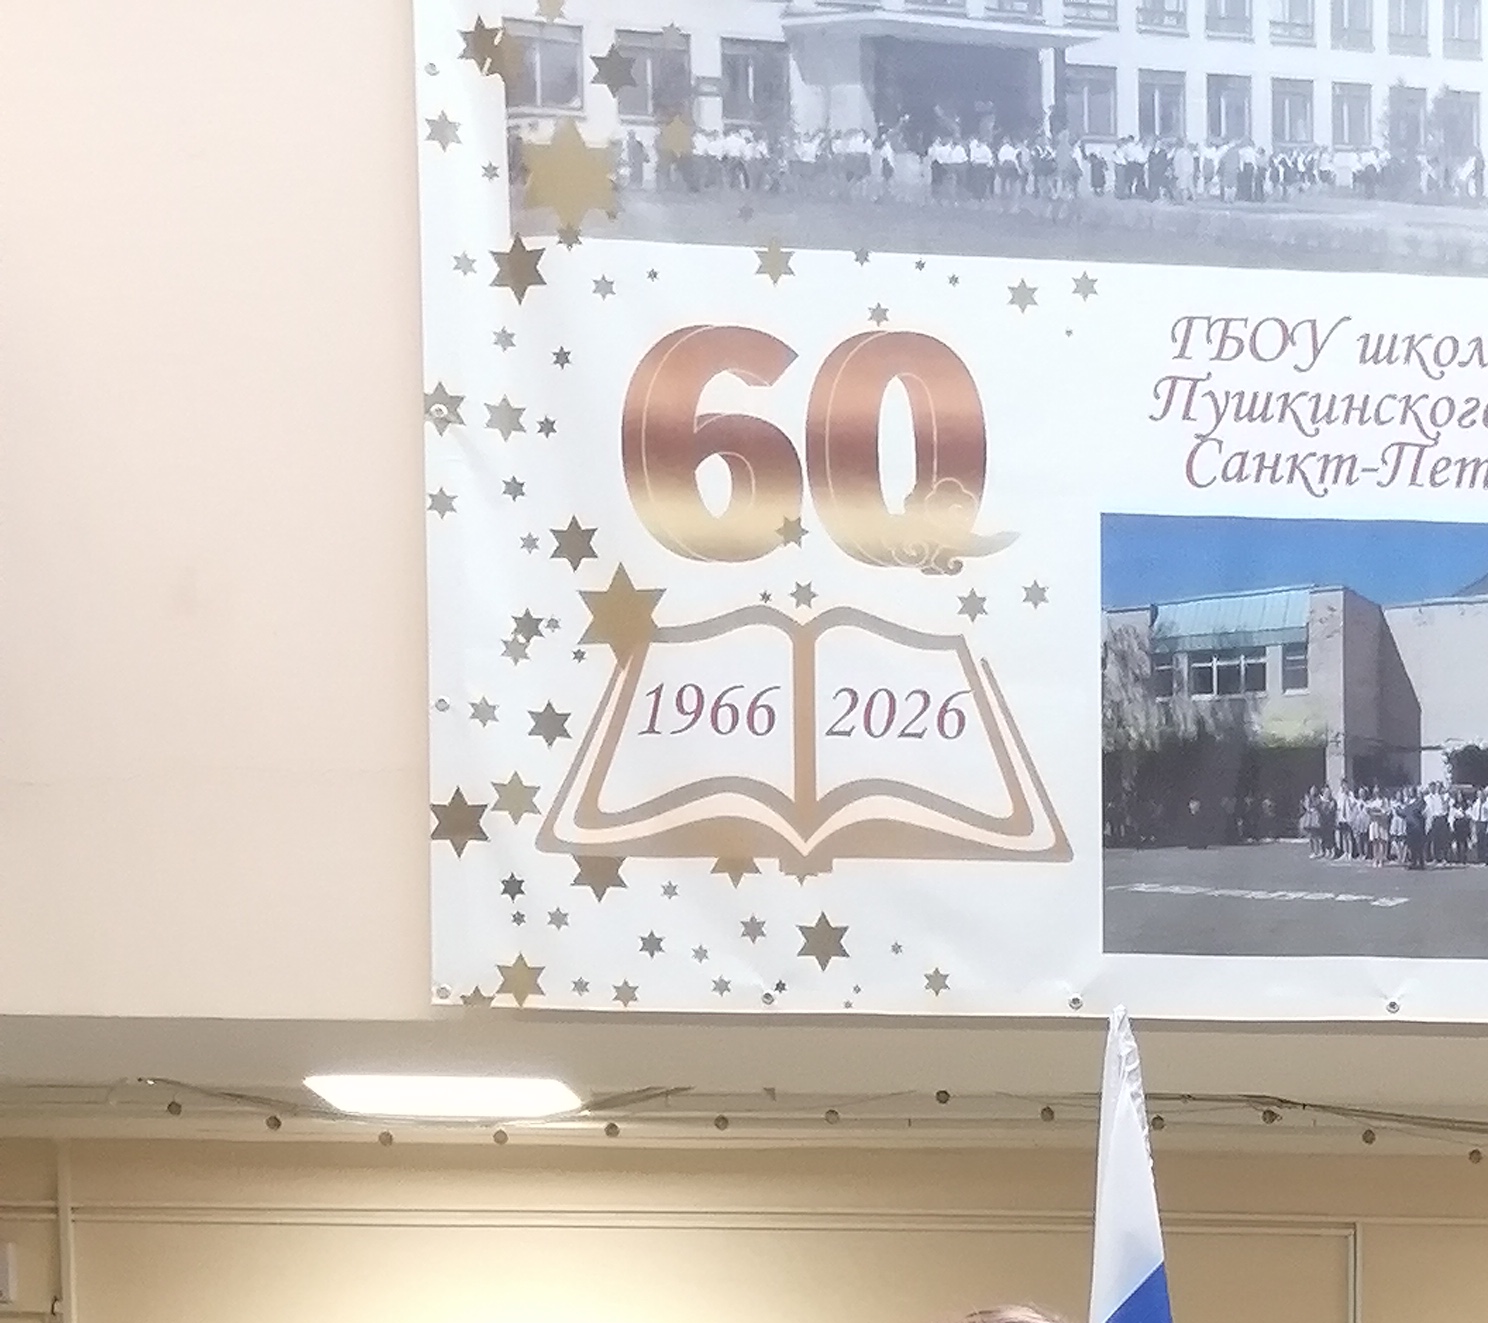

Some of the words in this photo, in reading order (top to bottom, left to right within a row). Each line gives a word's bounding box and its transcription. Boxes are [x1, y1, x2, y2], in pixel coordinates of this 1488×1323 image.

[1171, 316, 1351, 374] ГБОУ
[621, 325, 1004, 575] 60
[638, 683, 781, 737] 1966
[825, 687, 974, 740] 2026
